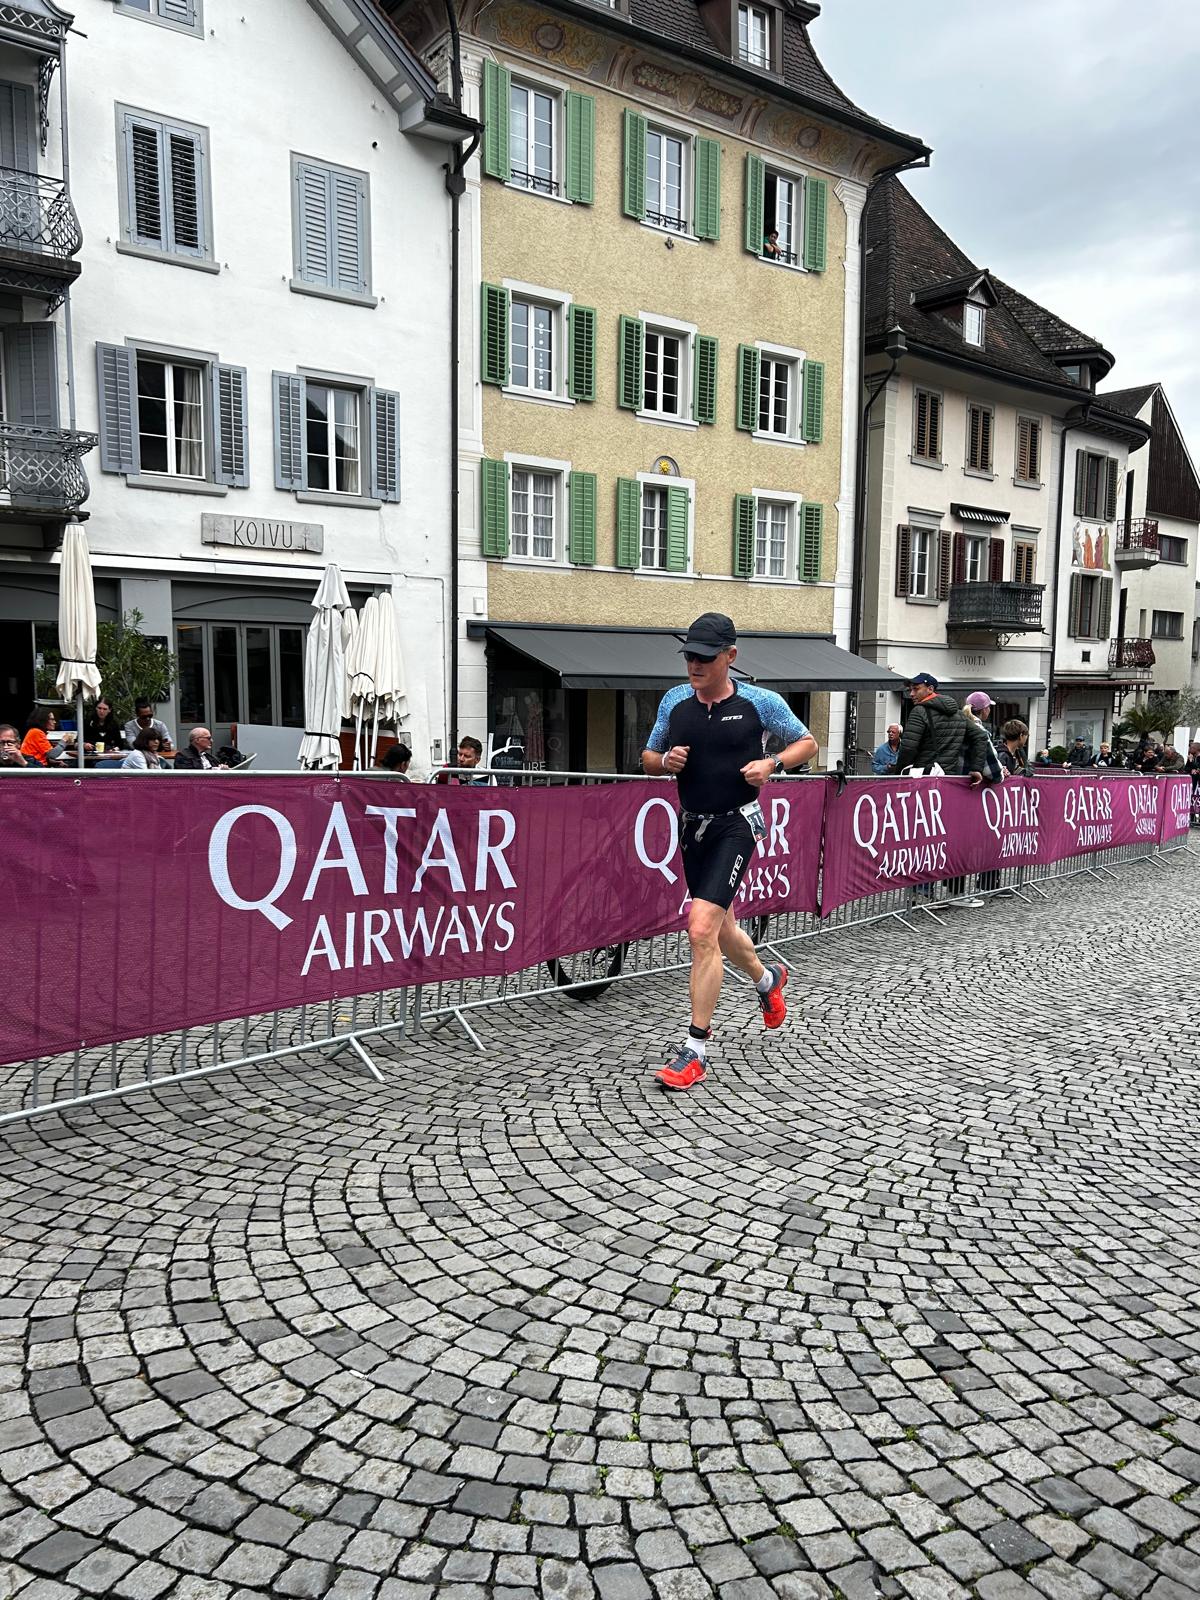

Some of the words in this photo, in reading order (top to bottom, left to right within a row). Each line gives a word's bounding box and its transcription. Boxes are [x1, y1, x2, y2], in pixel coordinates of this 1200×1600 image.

[233, 519, 293, 548] KOIVU
[853, 789, 947, 859] QATAR
[981, 786, 1040, 840] QATAR
[1064, 785, 1113, 830] QATAR
[1128, 784, 1159, 823] QATAR
[998, 831, 1039, 859] AIRWAYS
[1076, 823, 1113, 847] AIRWAYS
[208, 801, 517, 931] QATAR
[876, 841, 947, 880] AIRWAYS
[300, 901, 516, 976] AIRWAYS
